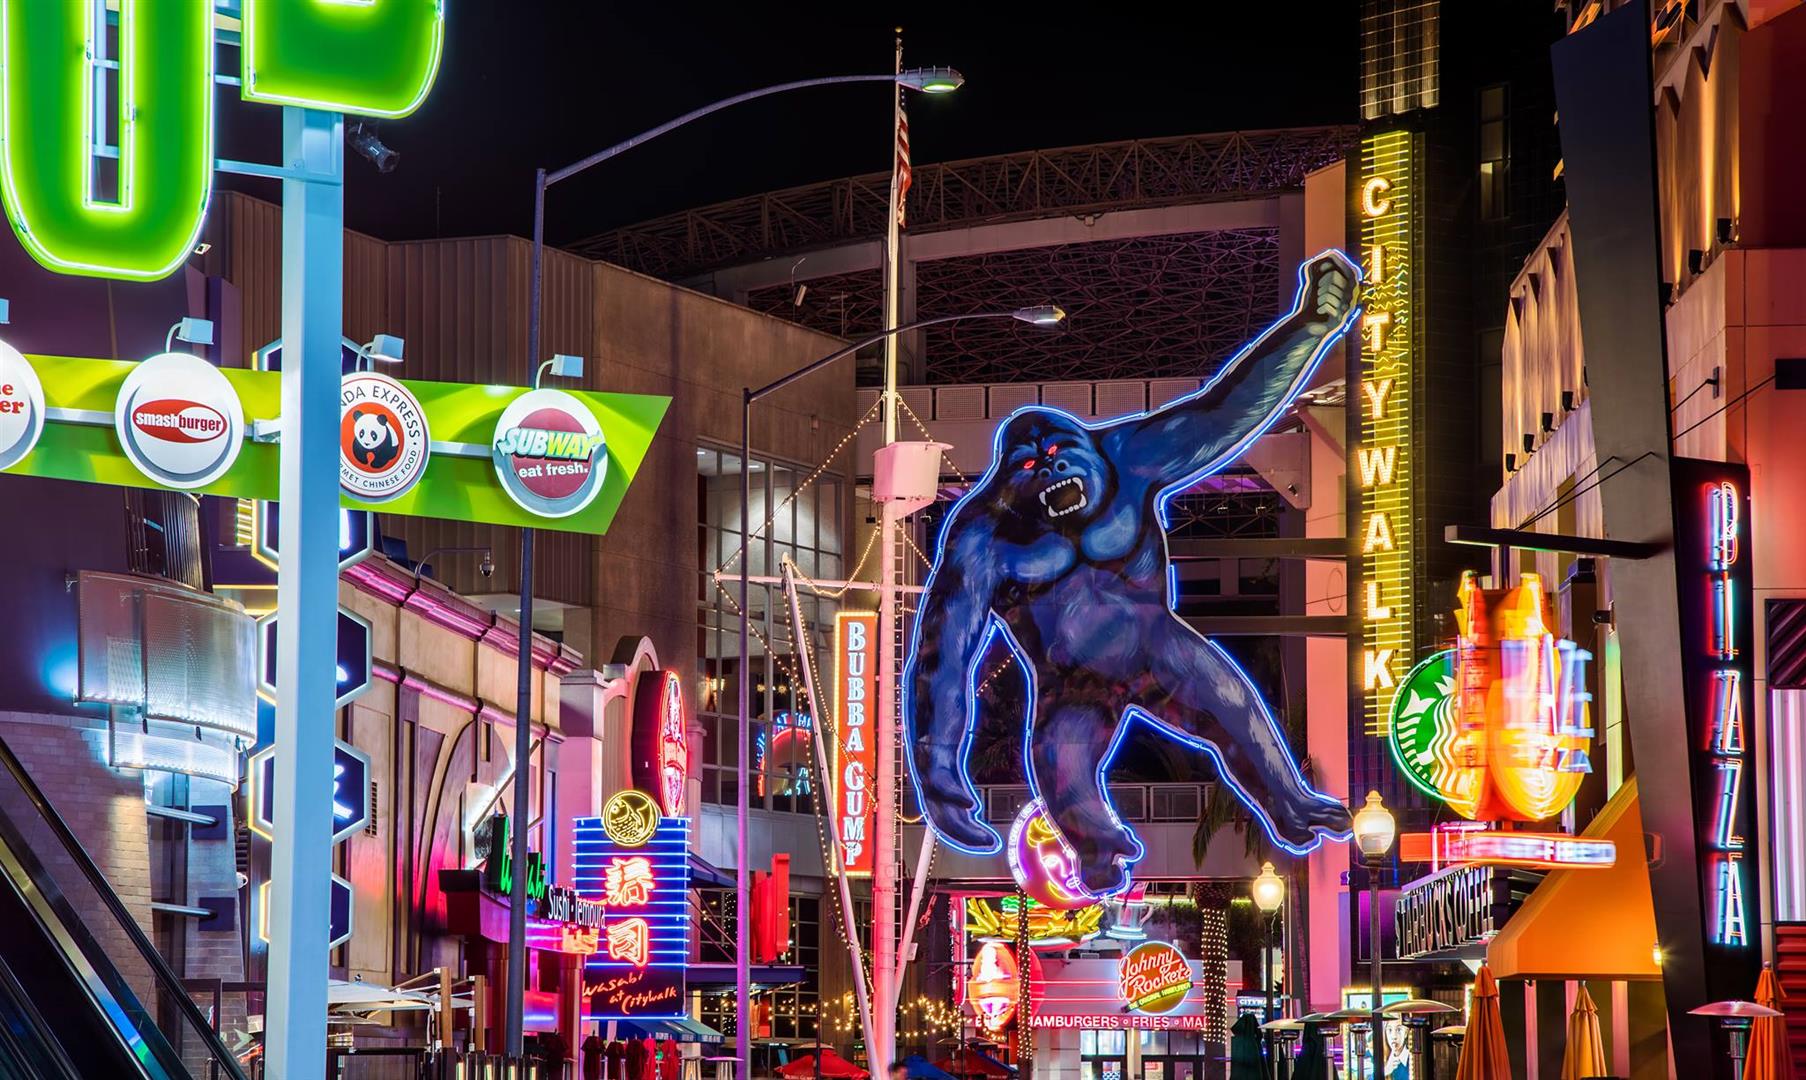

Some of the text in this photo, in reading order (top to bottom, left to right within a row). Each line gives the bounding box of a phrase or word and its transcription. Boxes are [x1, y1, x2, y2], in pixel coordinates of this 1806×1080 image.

[135, 411, 221, 432] smashburger
[372, 385, 421, 439] EXPRESS
[497, 427, 604, 461] SUBWAY
[1358, 177, 1398, 691] CITYWALK
[362, 474, 400, 489] CHINESE
[401, 449, 417, 475] FOOD
[519, 462, 588, 478] eat fresh.
[847, 621, 866, 751] BUBBA
[842, 760, 865, 866] GUMP
[548, 884, 570, 922] Sushi
[1395, 866, 1494, 960] STARBUCKS COFFEE
[1118, 948, 1180, 1000] Johnny
[1127, 962, 1192, 1001] Rockets
[609, 988, 624, 1004] at
[1132, 1016, 1169, 1028] FRIES
